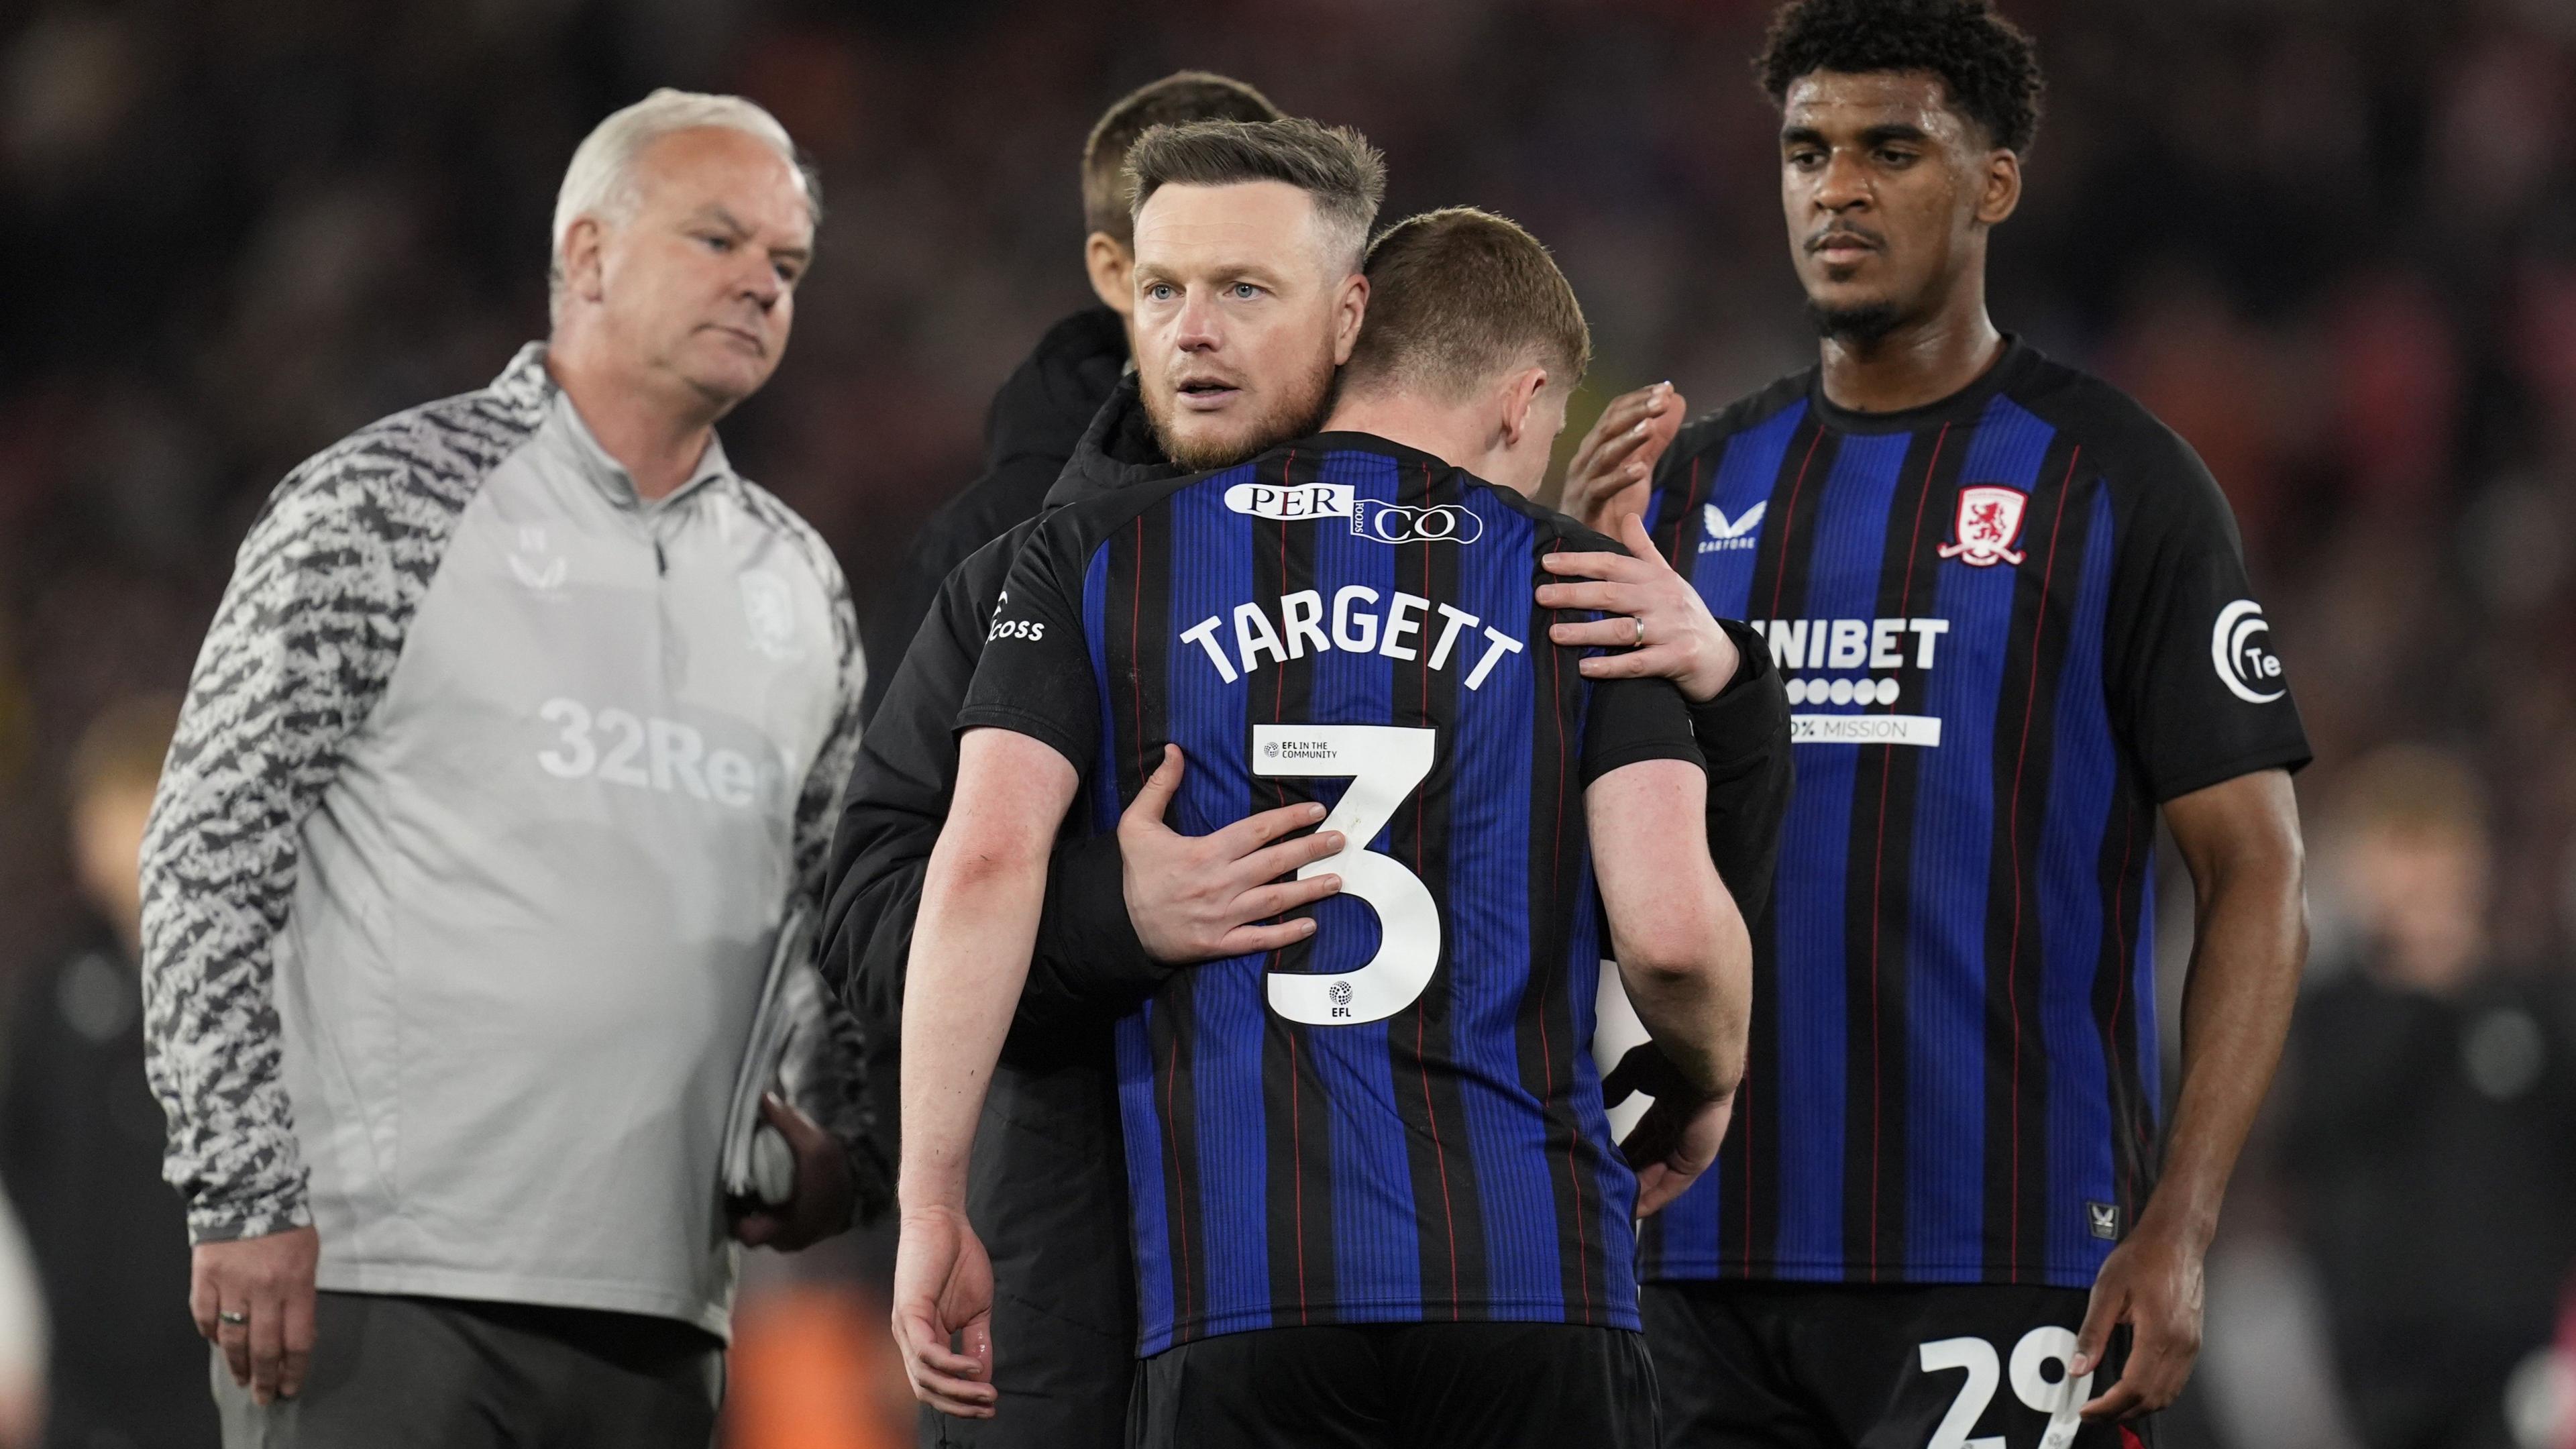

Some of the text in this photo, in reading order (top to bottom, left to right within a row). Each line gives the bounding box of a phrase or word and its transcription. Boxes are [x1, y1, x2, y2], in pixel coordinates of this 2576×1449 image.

[1248, 487, 1340, 517] PER
[1354, 502, 1364, 533] FOODS
[1375, 508, 1456, 541] CO
[1698, 537, 1756, 554] CASTORE
[1179, 585, 1524, 691] TARGETT
[1823, 720, 1907, 737] MISSION
[1252, 724, 1442, 1026] 3
[1332, 1008, 1351, 1017] EFL
[1919, 1326, 2094, 1449] 29
